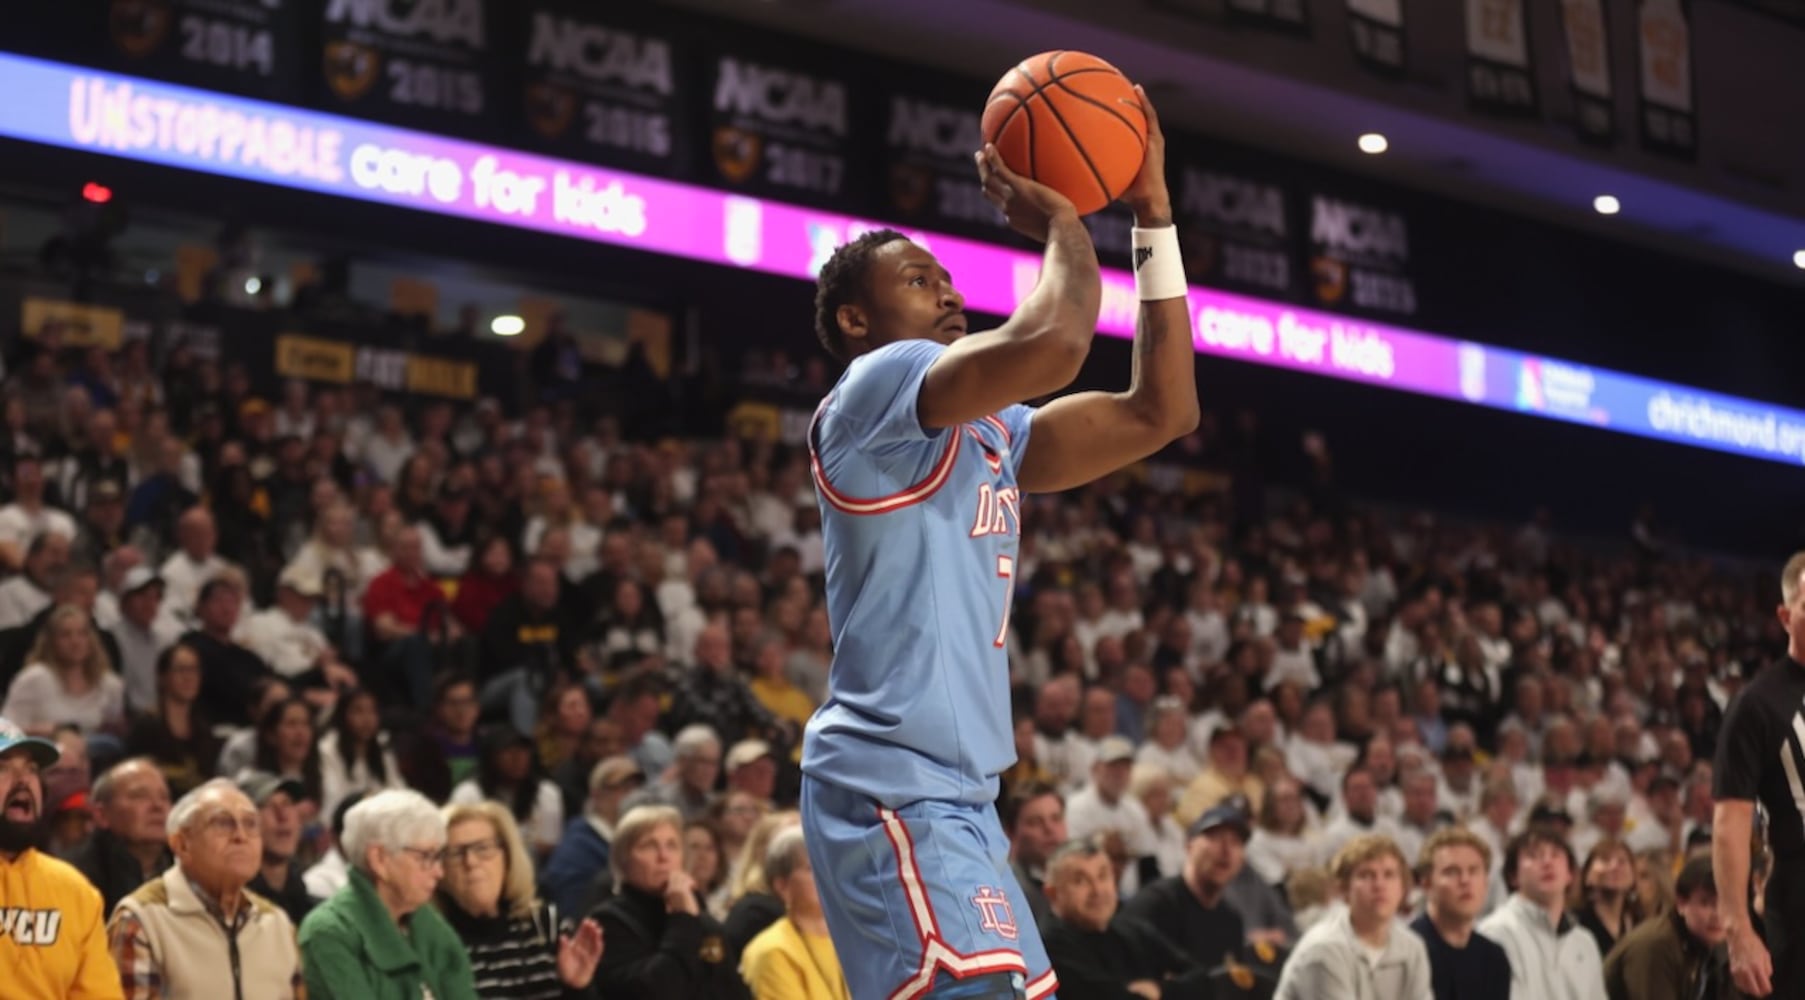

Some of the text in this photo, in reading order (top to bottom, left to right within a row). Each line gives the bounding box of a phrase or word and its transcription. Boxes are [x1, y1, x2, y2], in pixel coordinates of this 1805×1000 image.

[180, 15, 274, 77] 2014
[528, 11, 673, 95] NCAA
[386, 58, 483, 114] 2015
[713, 55, 847, 136] NCAA
[69, 76, 346, 183] UNSTOPPABLE
[350, 143, 463, 203] care
[469, 154, 547, 217] for
[553, 169, 648, 238] kids
[1182, 168, 1287, 237] NCAA
[1310, 195, 1409, 262] NCAA
[1200, 306, 1395, 380] care for kids
[1648, 388, 1805, 462] chrichmond.or
[993, 554, 1013, 649] 7
[0, 906, 62, 947] VCU
